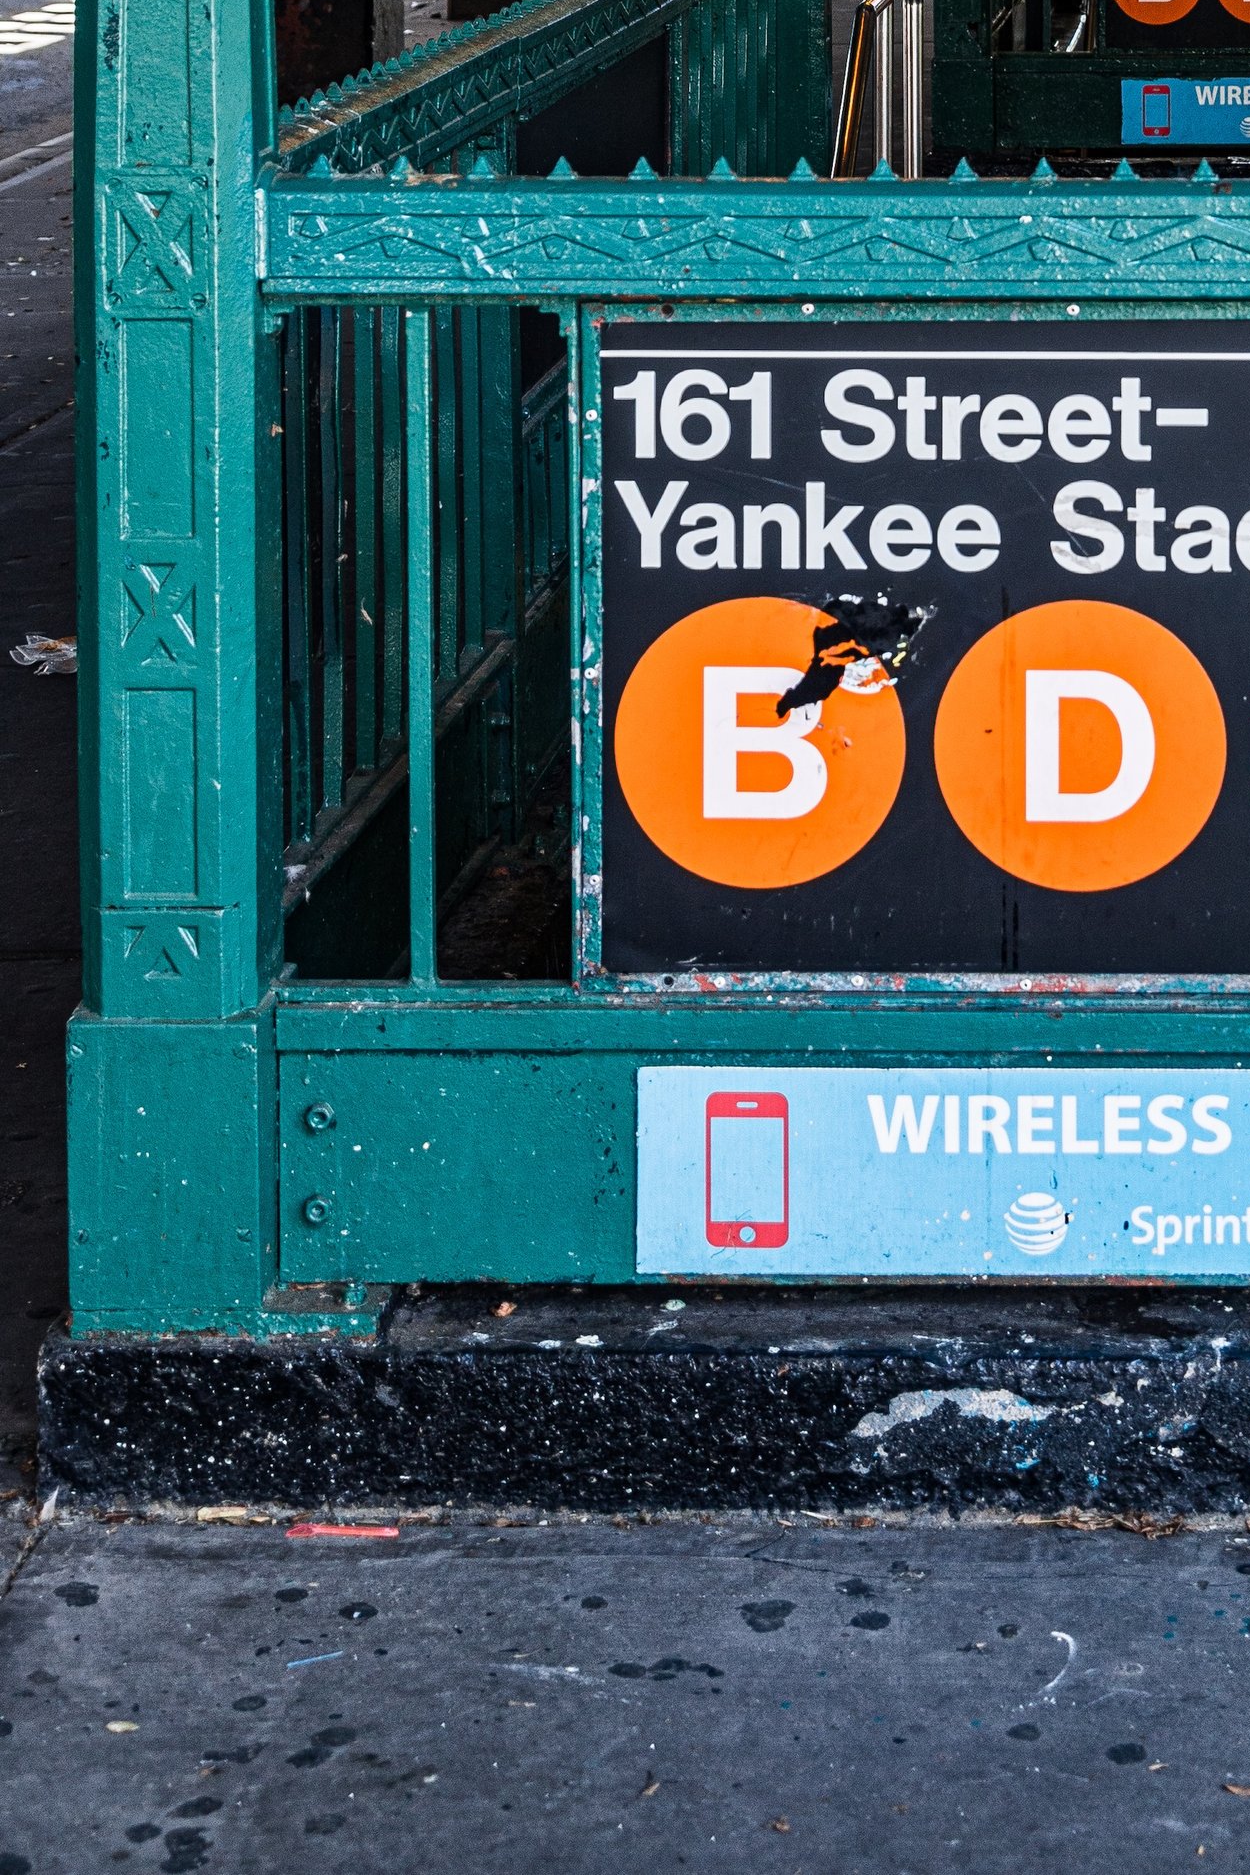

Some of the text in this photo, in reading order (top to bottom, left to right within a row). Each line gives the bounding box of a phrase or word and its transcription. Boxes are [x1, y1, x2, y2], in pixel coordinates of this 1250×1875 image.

[612, 368, 1210, 464] 161 Street-
[613, 479, 1001, 573] Yankee
[702, 665, 828, 820] B
[1024, 669, 1156, 823] D
[866, 1093, 1234, 1155] WIRELESS
